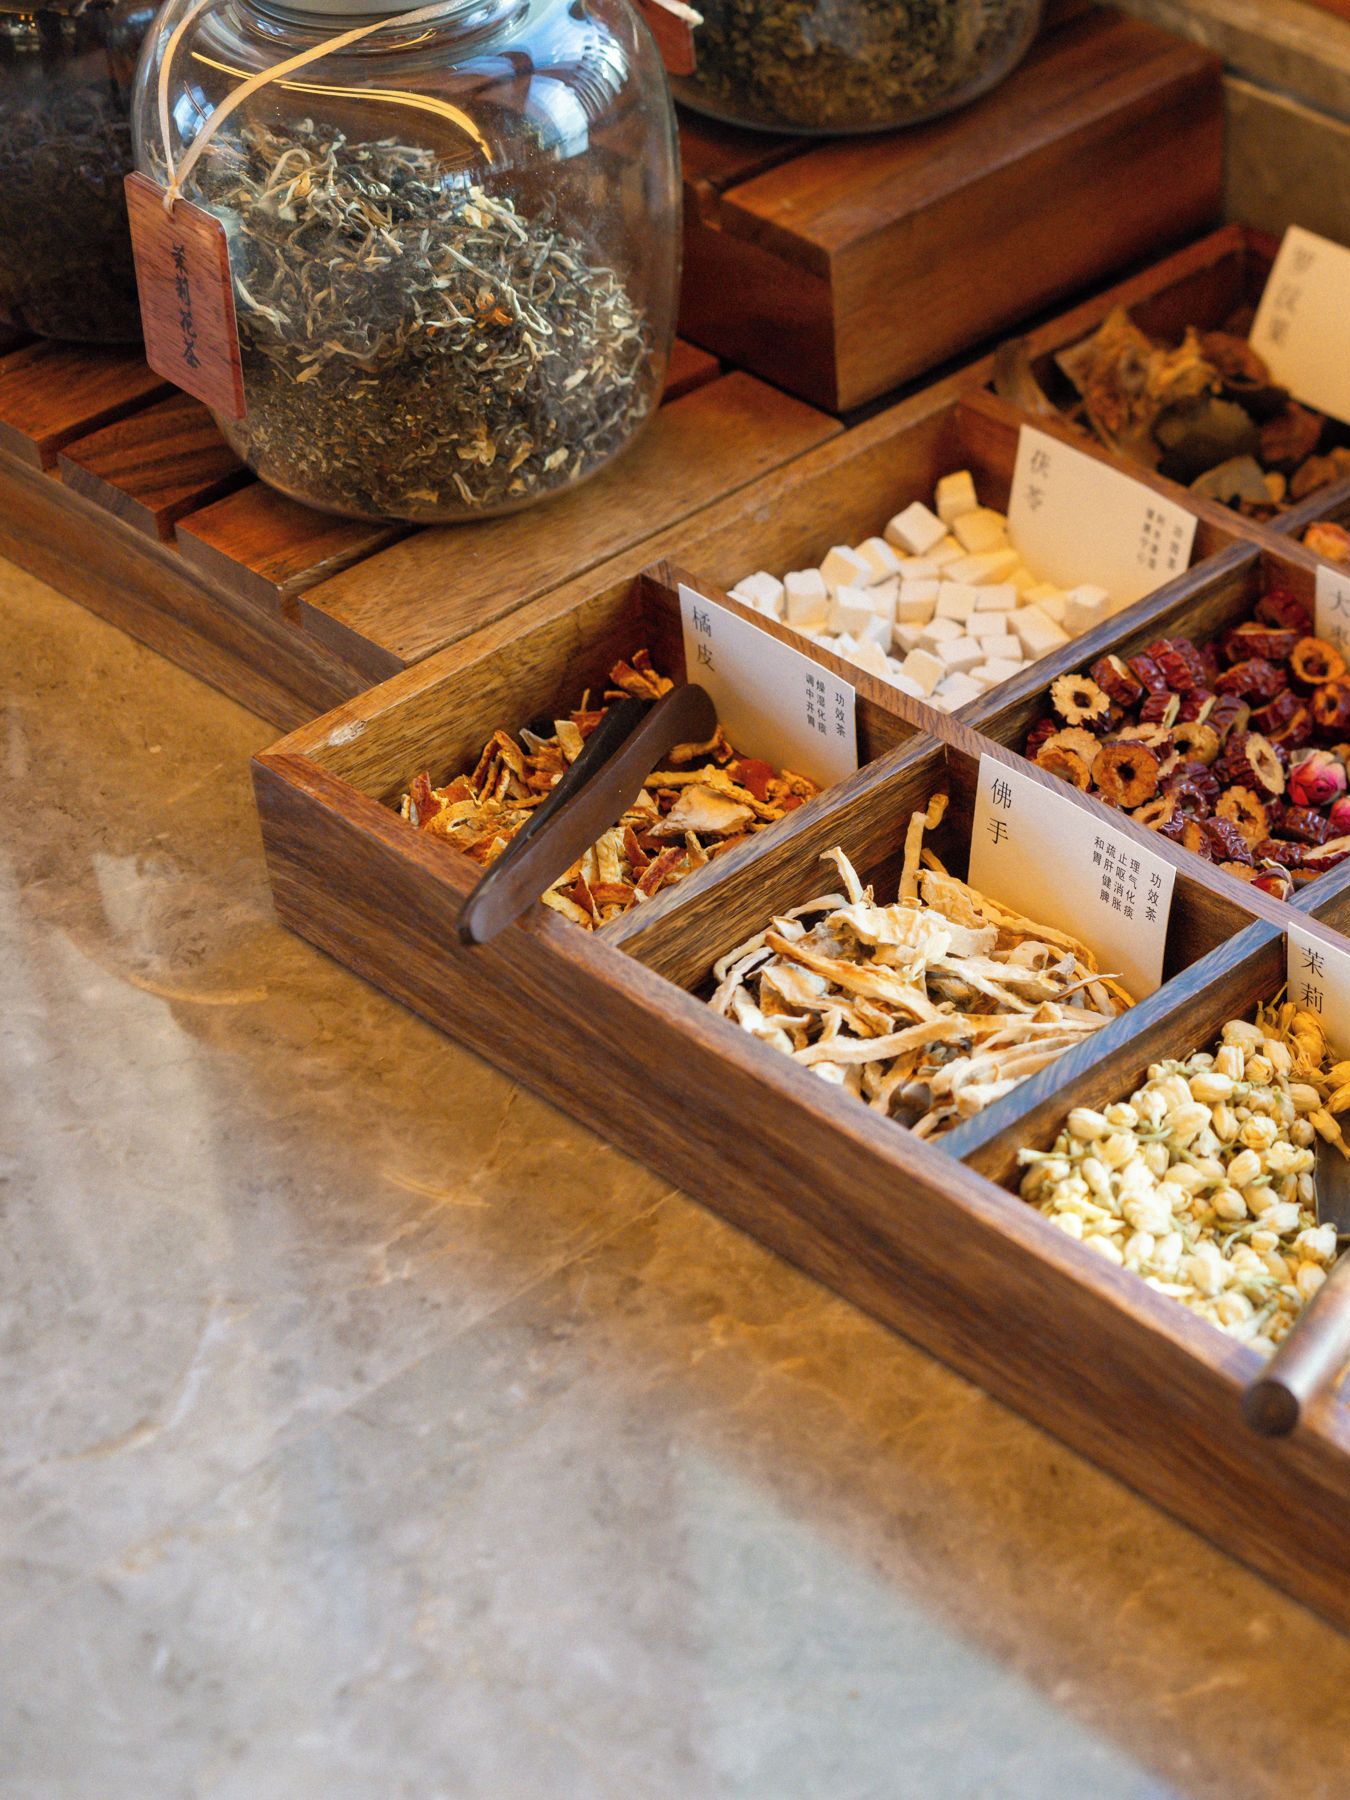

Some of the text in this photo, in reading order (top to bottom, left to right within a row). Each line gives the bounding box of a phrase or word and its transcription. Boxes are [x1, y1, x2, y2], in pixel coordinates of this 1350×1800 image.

[693, 605, 715, 672] 橘皮
[835, 692, 846, 738] 功效茶
[986, 777, 1012, 844] 佛手
[1092, 835, 1105, 867] 和胃
[1100, 843, 1116, 904] 疏肝健脾
[1111, 852, 1128, 913] 止呕消胀
[1123, 858, 1141, 920] 理气化痰
[1145, 872, 1162, 922] 功效茶
[1301, 946, 1325, 1014] 茉莉
